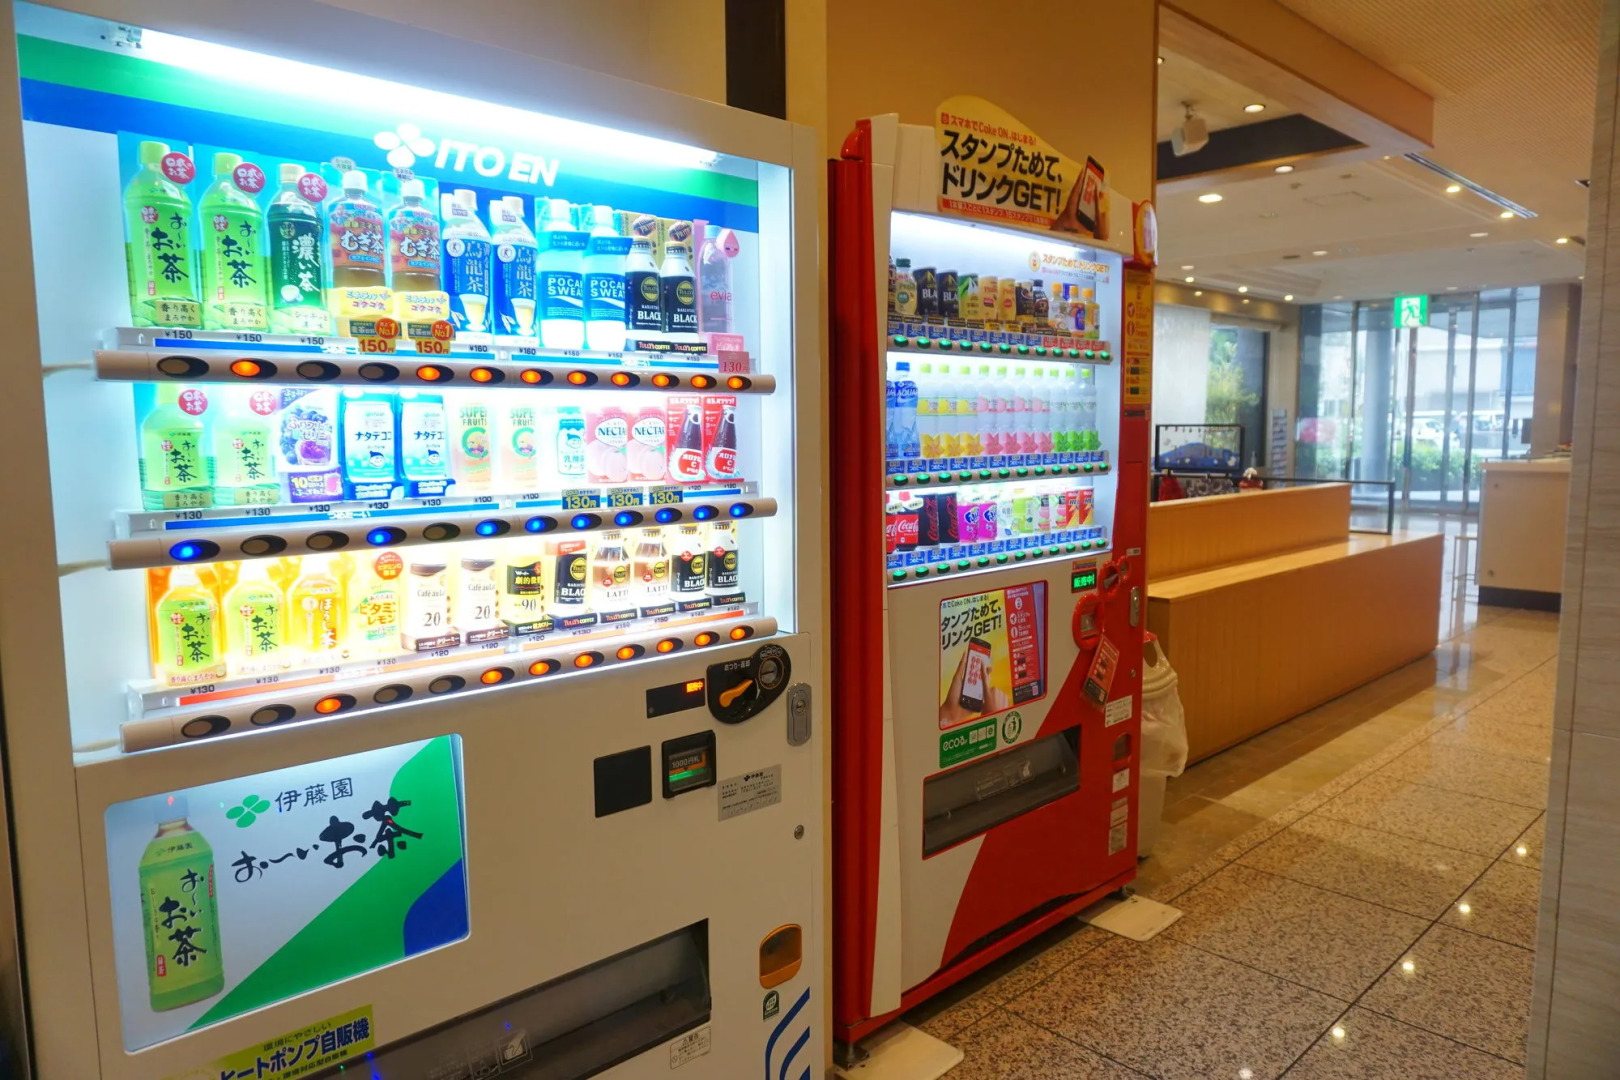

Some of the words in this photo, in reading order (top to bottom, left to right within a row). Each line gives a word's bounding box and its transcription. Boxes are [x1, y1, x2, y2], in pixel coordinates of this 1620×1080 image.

[434, 139, 505, 177] ITO
[508, 151, 560, 187] EN
[941, 130, 1062, 183] スタンプためて、
[942, 163, 1061, 214] ドリンクGET!
[340, 232, 383, 254] むぎ茶
[151, 227, 189, 283] お茶
[222, 235, 256, 288] お茶
[291, 232, 320, 293] 濃い茶
[165, 330, 193, 339] ¥150
[236, 334, 262, 342] ¥150
[301, 337, 324, 345] ¥150
[359, 340, 394, 353] 150円
[417, 341, 449, 354] 150円
[170, 449, 197, 483] お茶
[565, 496, 596, 508] 130円
[608, 493, 639, 506] 130円
[653, 491, 680, 504] 130円
[245, 508, 270, 516] ¥130
[309, 504, 330, 512] ¥130
[175, 511, 202, 520] ¥130
[522, 599, 537, 611] 90
[474, 605, 490, 620] 20
[367, 614, 395, 626] レモン
[424, 612, 440, 627] 20
[252, 615, 278, 652] お茶
[181, 623, 210, 663] お茶
[319, 666, 341, 674] ¥130
[256, 676, 279, 684] ¥130
[190, 685, 215, 694] ¥130
[671, 756, 700, 769] 1000円札
[274, 776, 353, 812] 伊藤園
[158, 896, 207, 968] お茶
[263, 1021, 332, 1051] 環境にやさしい
